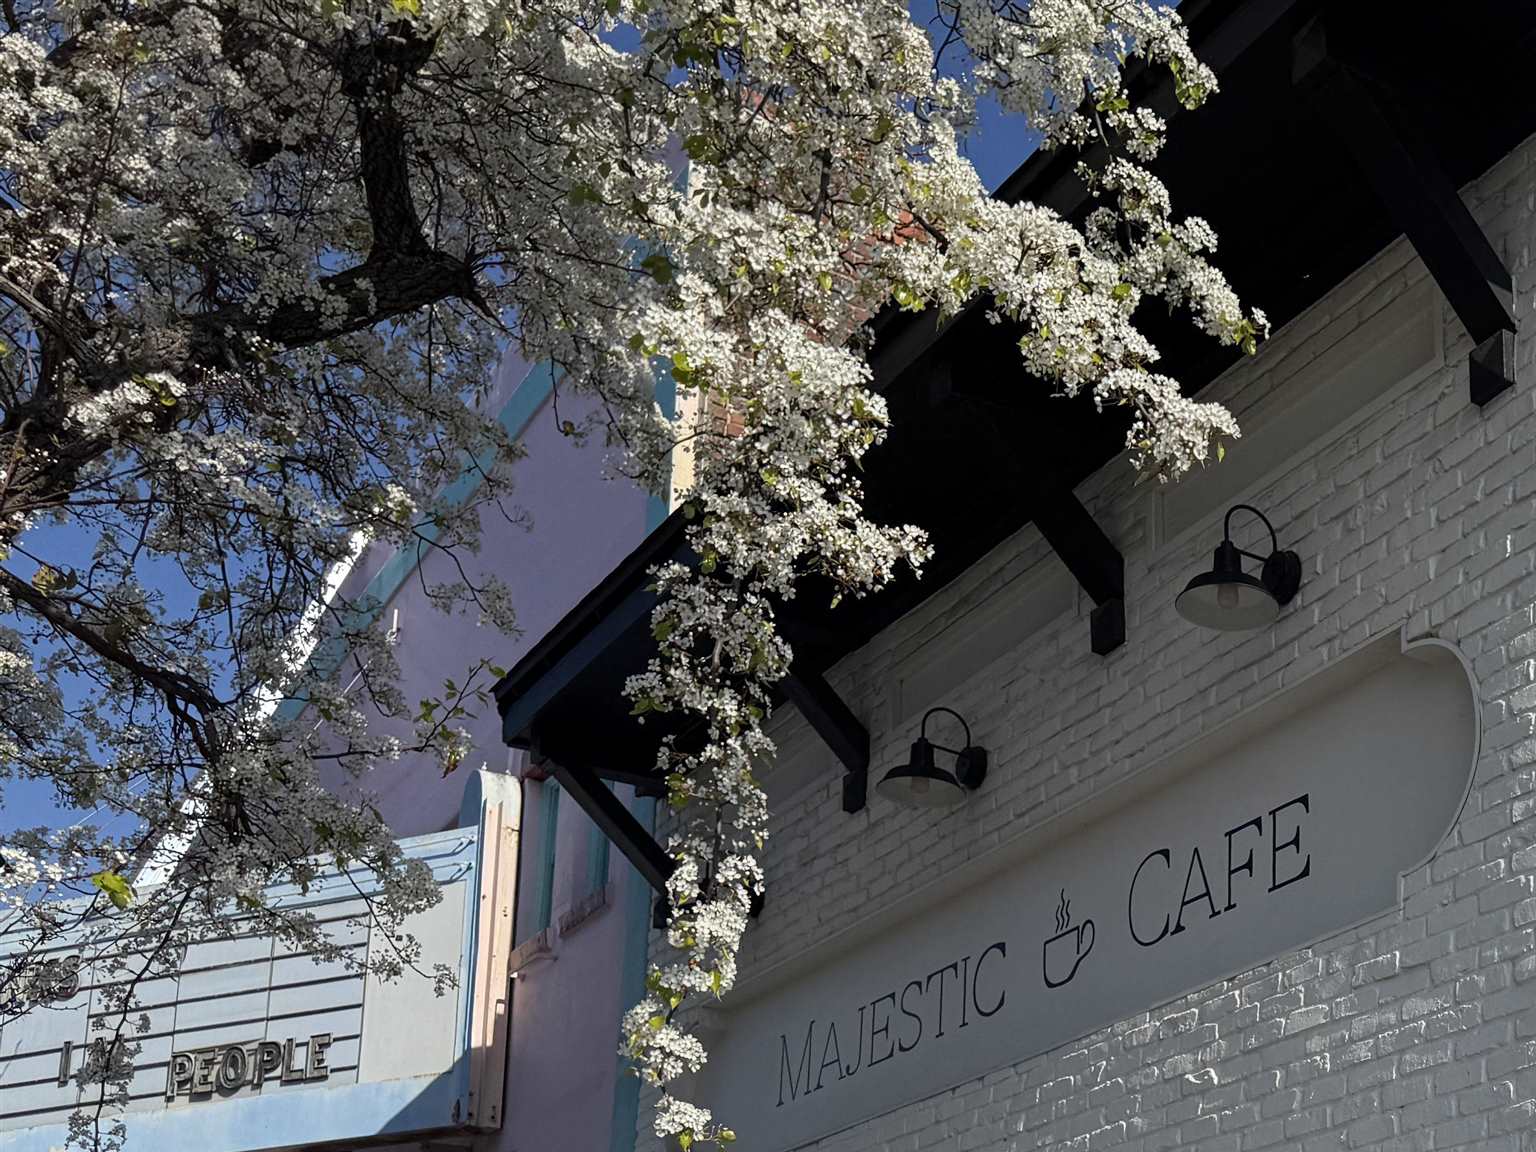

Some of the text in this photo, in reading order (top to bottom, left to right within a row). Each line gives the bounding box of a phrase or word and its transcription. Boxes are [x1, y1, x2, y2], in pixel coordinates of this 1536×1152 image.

[776, 794, 1311, 1108] MAJESTIC CAFE
[166, 1032, 333, 1101] PEOPLE
